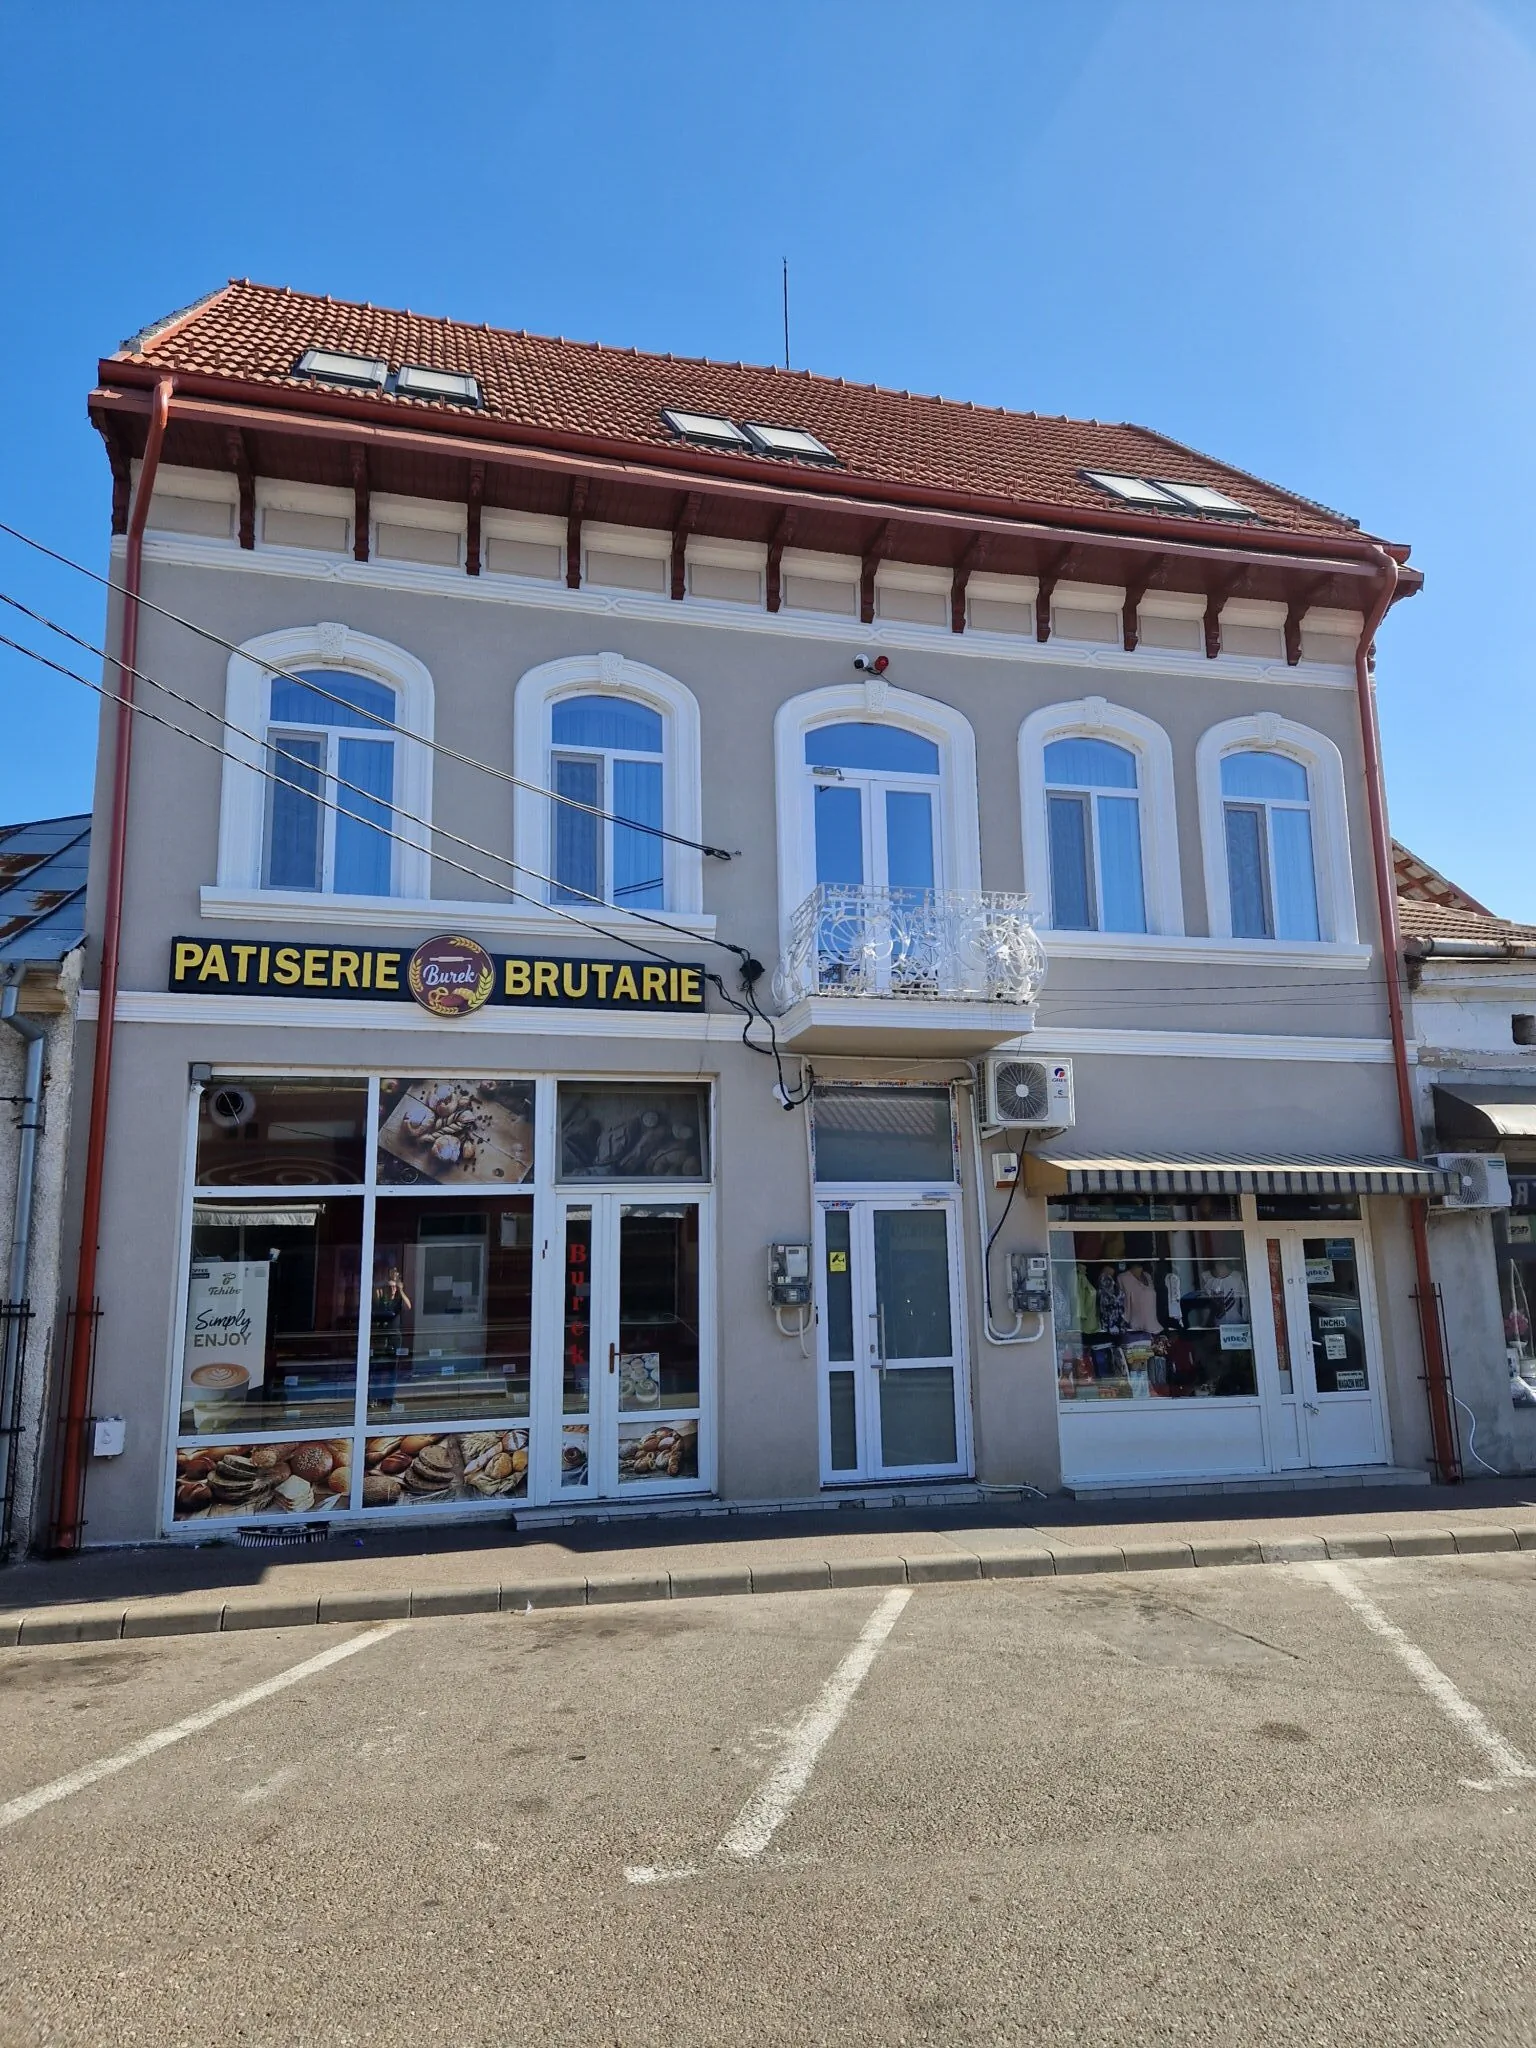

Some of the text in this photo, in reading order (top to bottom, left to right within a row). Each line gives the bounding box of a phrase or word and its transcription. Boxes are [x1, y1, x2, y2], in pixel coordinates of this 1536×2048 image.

[174, 942, 704, 1003] PATISERIE Burek BRUTARIE
[208, 1286, 243, 1296] Tchibo
[569, 1243, 587, 1366] Burek
[194, 1308, 252, 1334] Simply
[193, 1331, 252, 1348] ENJOY
[1223, 1335, 1248, 1343] VIDEO
